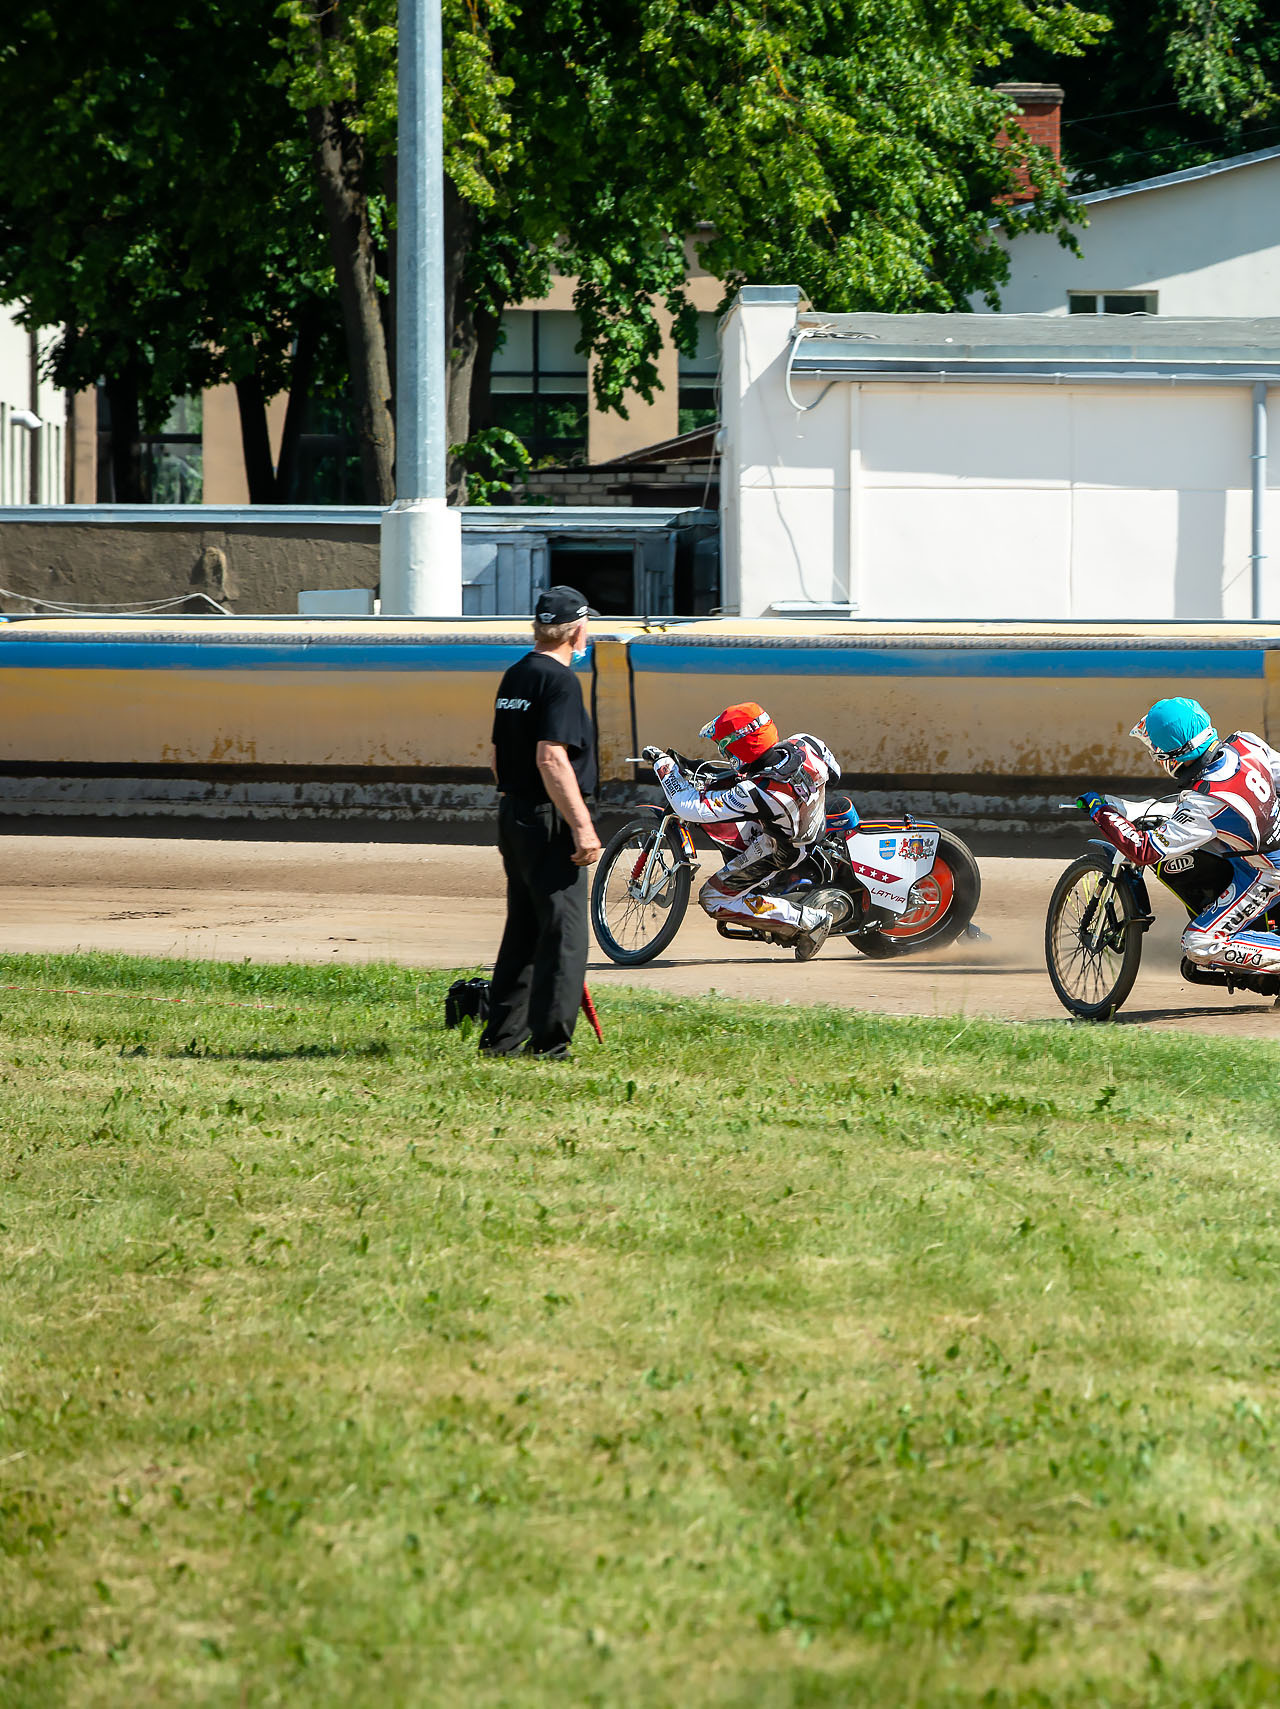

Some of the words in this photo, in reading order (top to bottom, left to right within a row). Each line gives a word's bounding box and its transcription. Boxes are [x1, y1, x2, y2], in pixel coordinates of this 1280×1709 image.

[1244, 768, 1271, 803] 8
[870, 887, 906, 904] LATVIA
[1224, 949, 1263, 966] DARO
